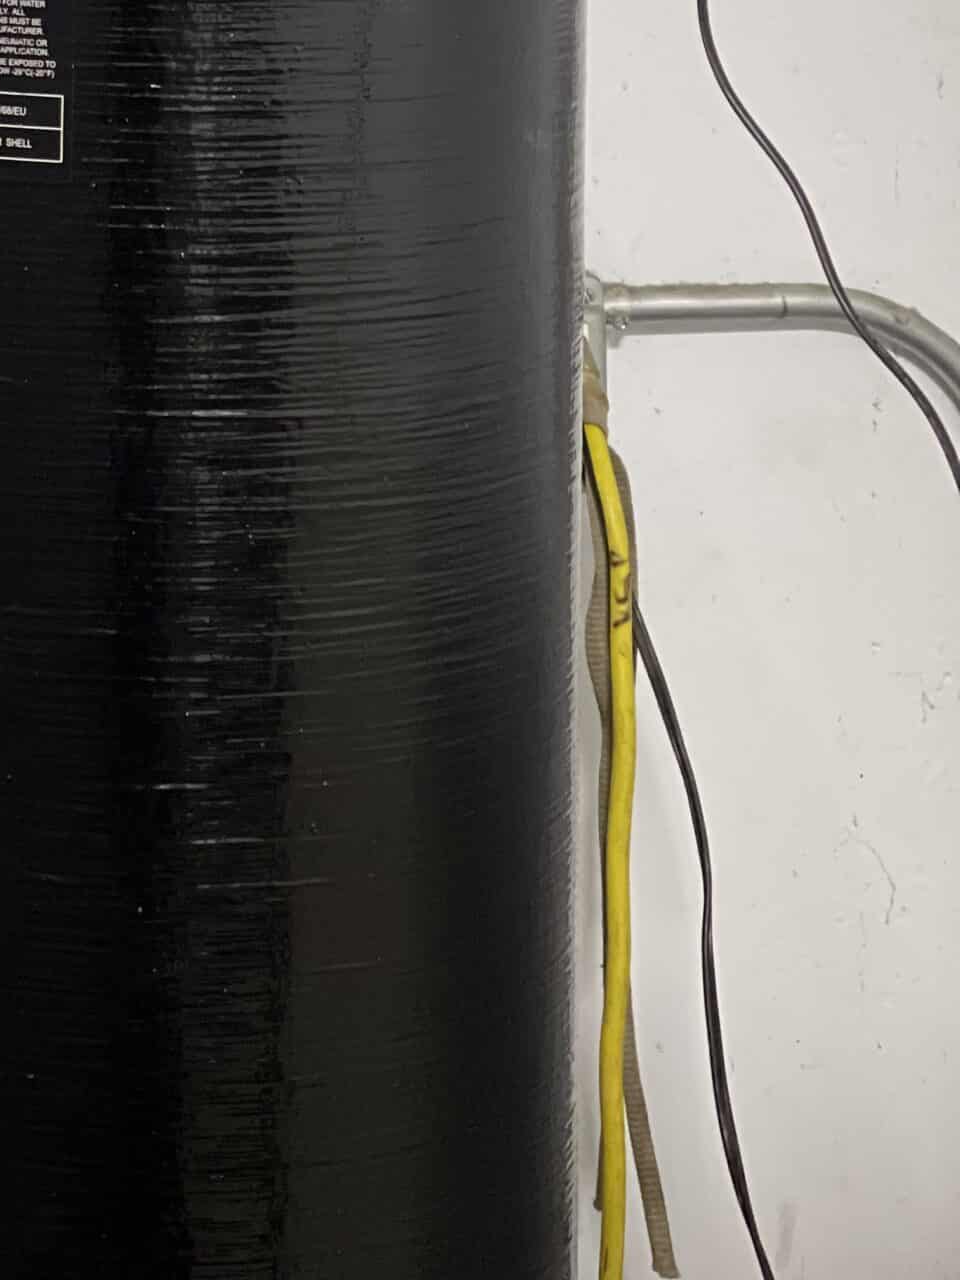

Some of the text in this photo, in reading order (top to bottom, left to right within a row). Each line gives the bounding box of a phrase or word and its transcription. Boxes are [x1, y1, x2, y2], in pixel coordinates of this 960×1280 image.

[19, 0, 46, 8] WATER
[11, 8, 26, 16] ALL
[9, 17, 30, 25] MUST
[31, 18, 42, 26] BE
[36, 39, 48, 47] OR
[9, 58, 44, 68] EXPOSED
[46, 60, 56, 68] TO
[5, 137, 32, 149] SHELL
